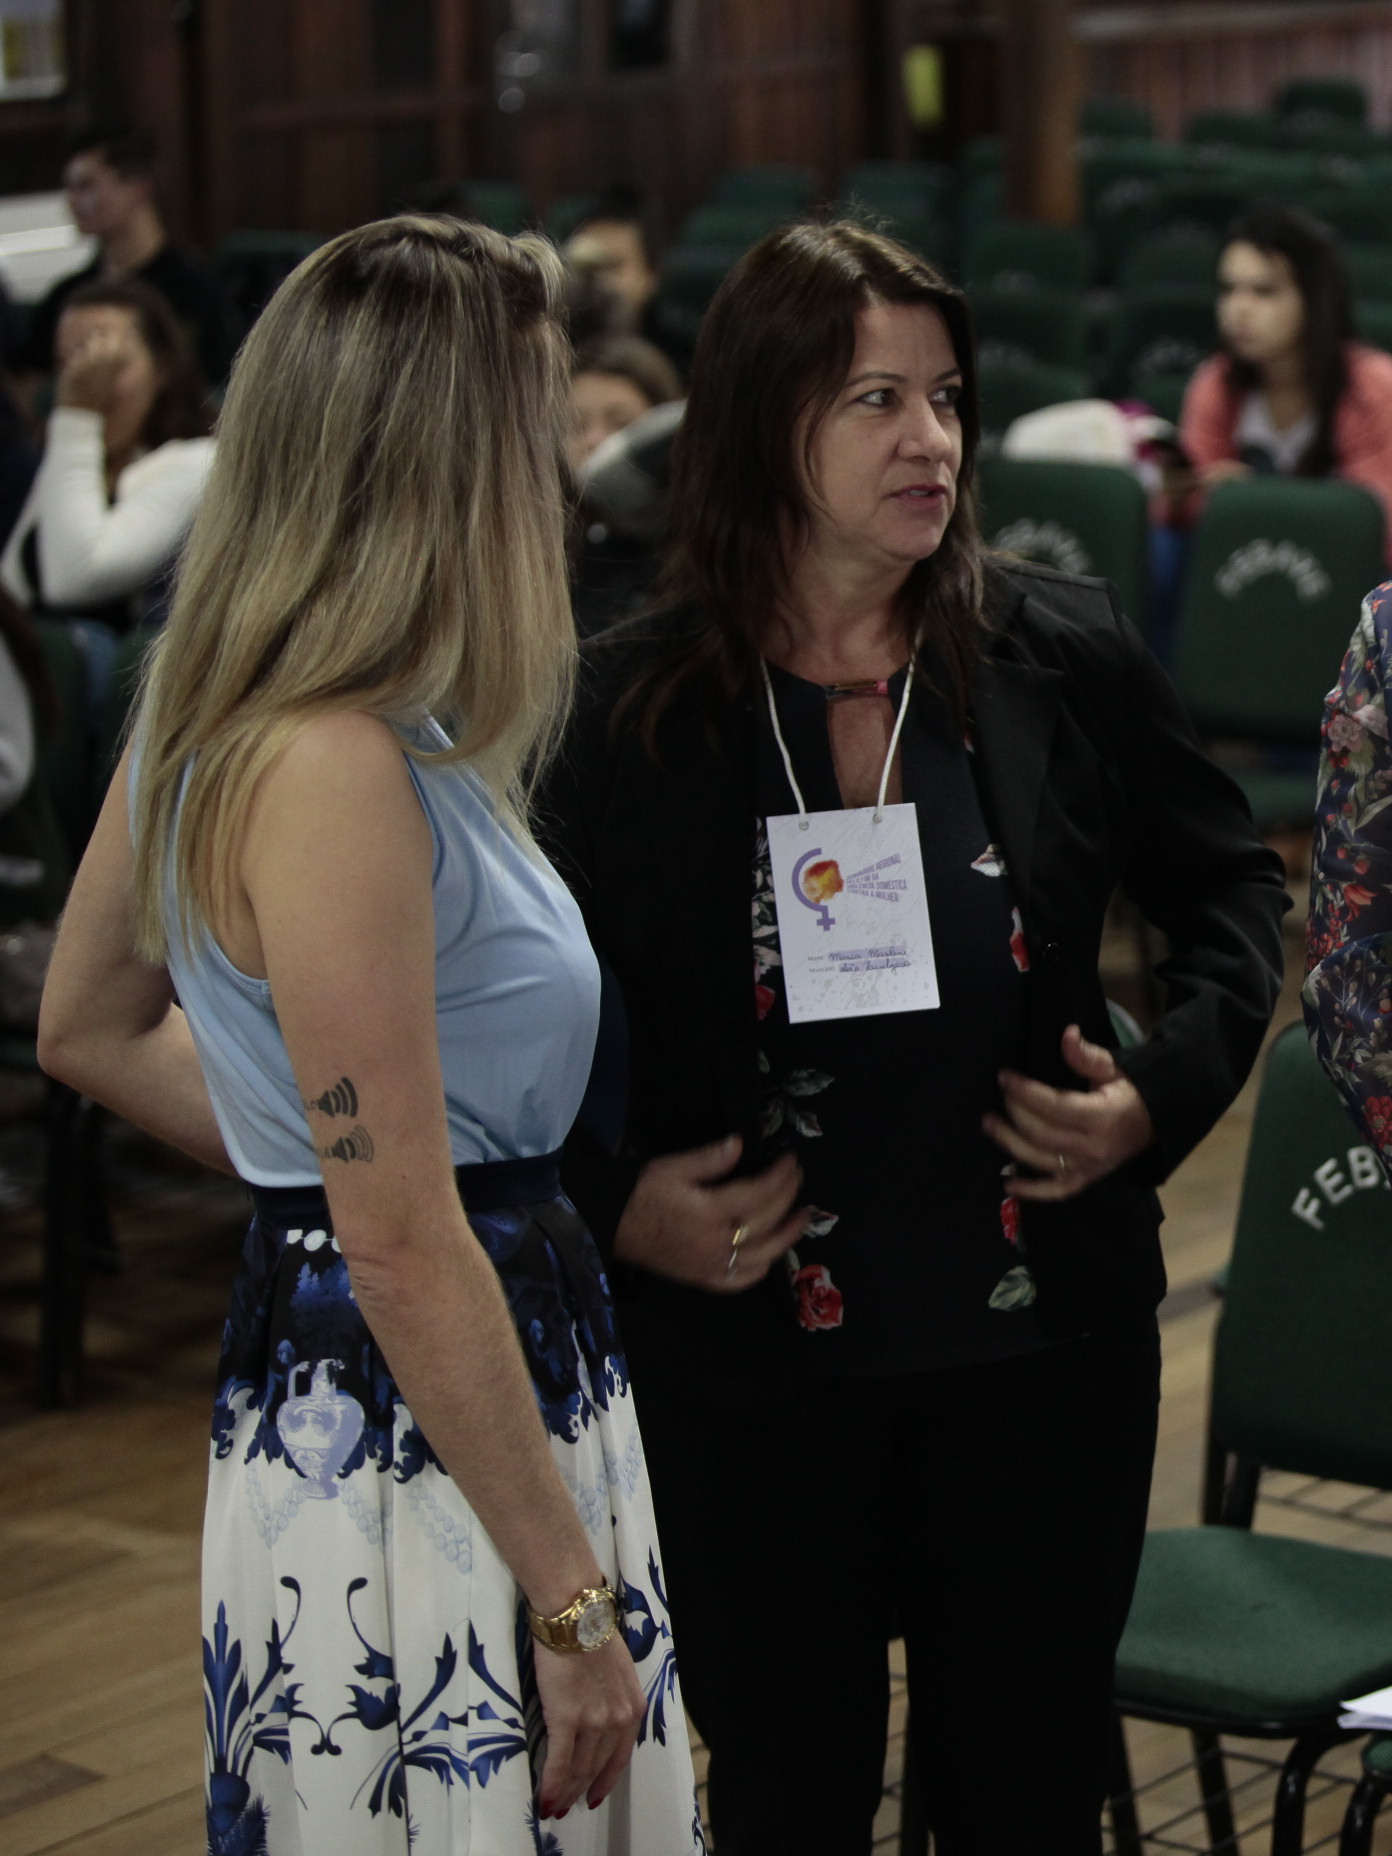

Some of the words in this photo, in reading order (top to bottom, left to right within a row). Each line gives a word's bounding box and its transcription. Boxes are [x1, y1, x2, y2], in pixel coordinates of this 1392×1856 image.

[872, 873, 879, 881] DA
[875, 891, 899, 902] MULHER
[1290, 1145, 1391, 1231] FEB
